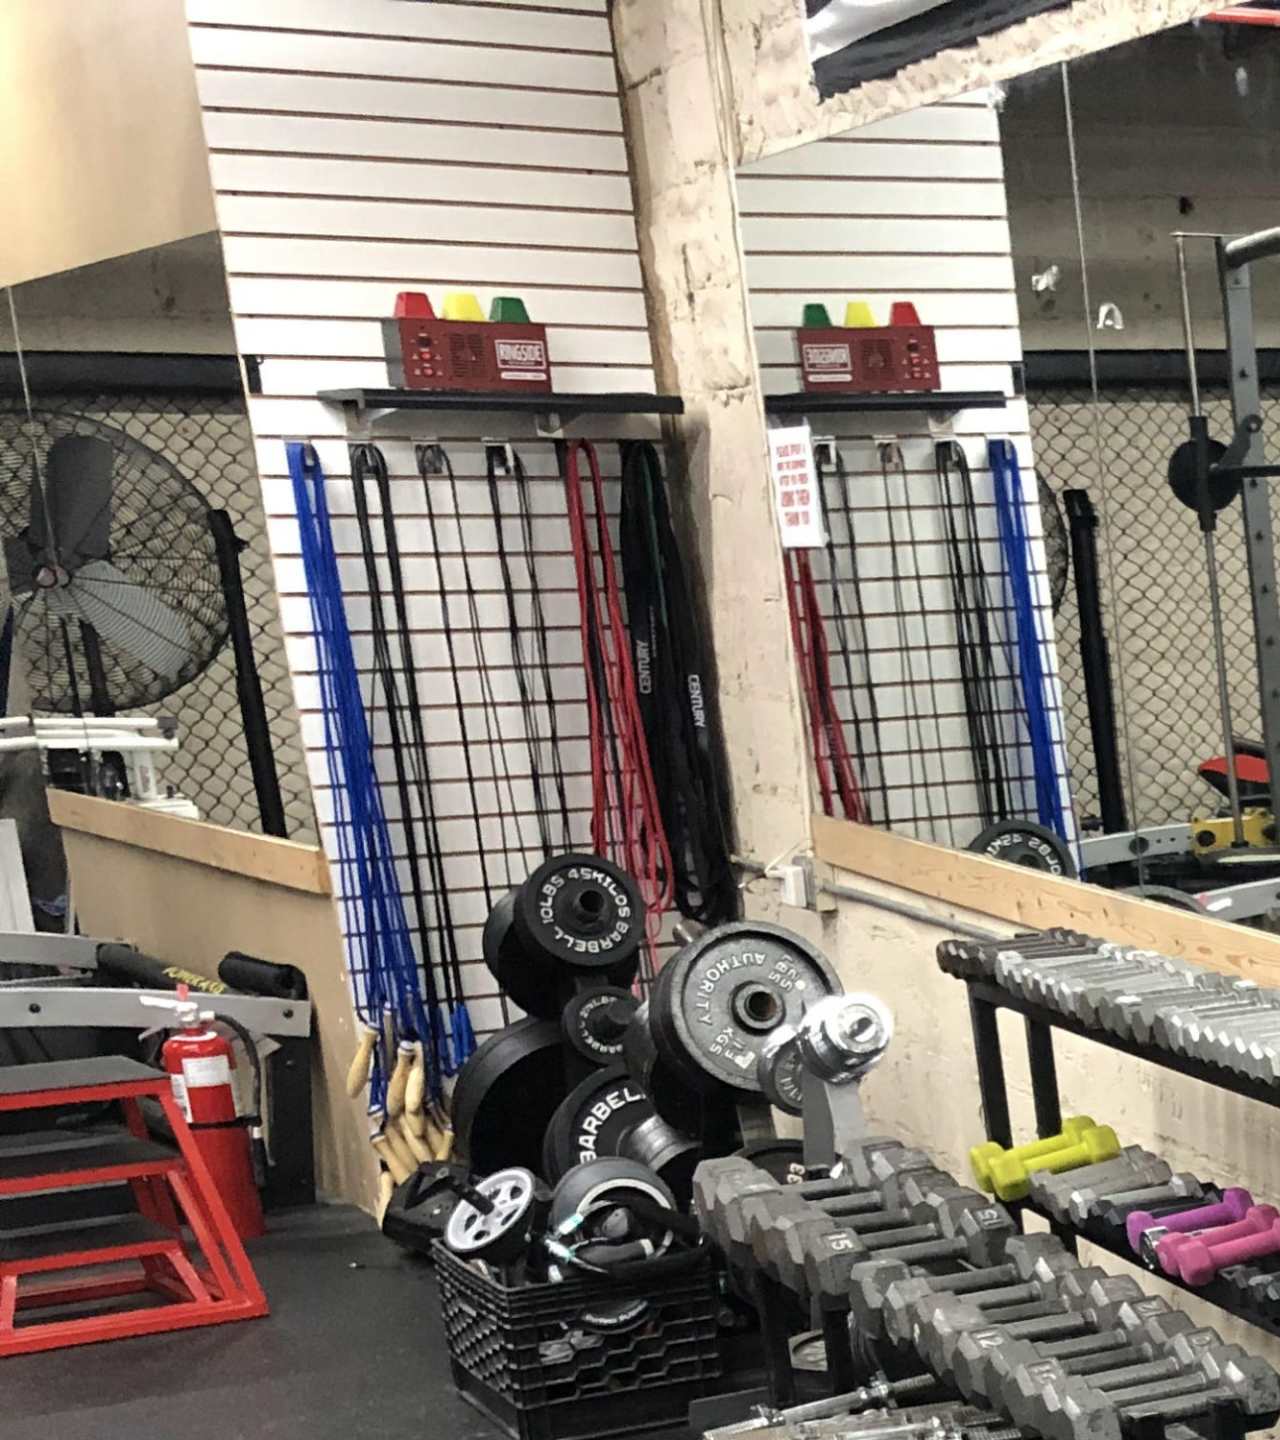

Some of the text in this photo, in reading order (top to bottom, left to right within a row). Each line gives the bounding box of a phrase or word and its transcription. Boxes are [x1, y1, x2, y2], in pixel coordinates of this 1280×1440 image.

[688, 674, 705, 727] CENTURY
[554, 921, 630, 953] BARBELL
[696, 952, 766, 1026] AUTHORITY
[579, 1088, 647, 1164] BARBEL
[829, 1233, 854, 1251] 15
